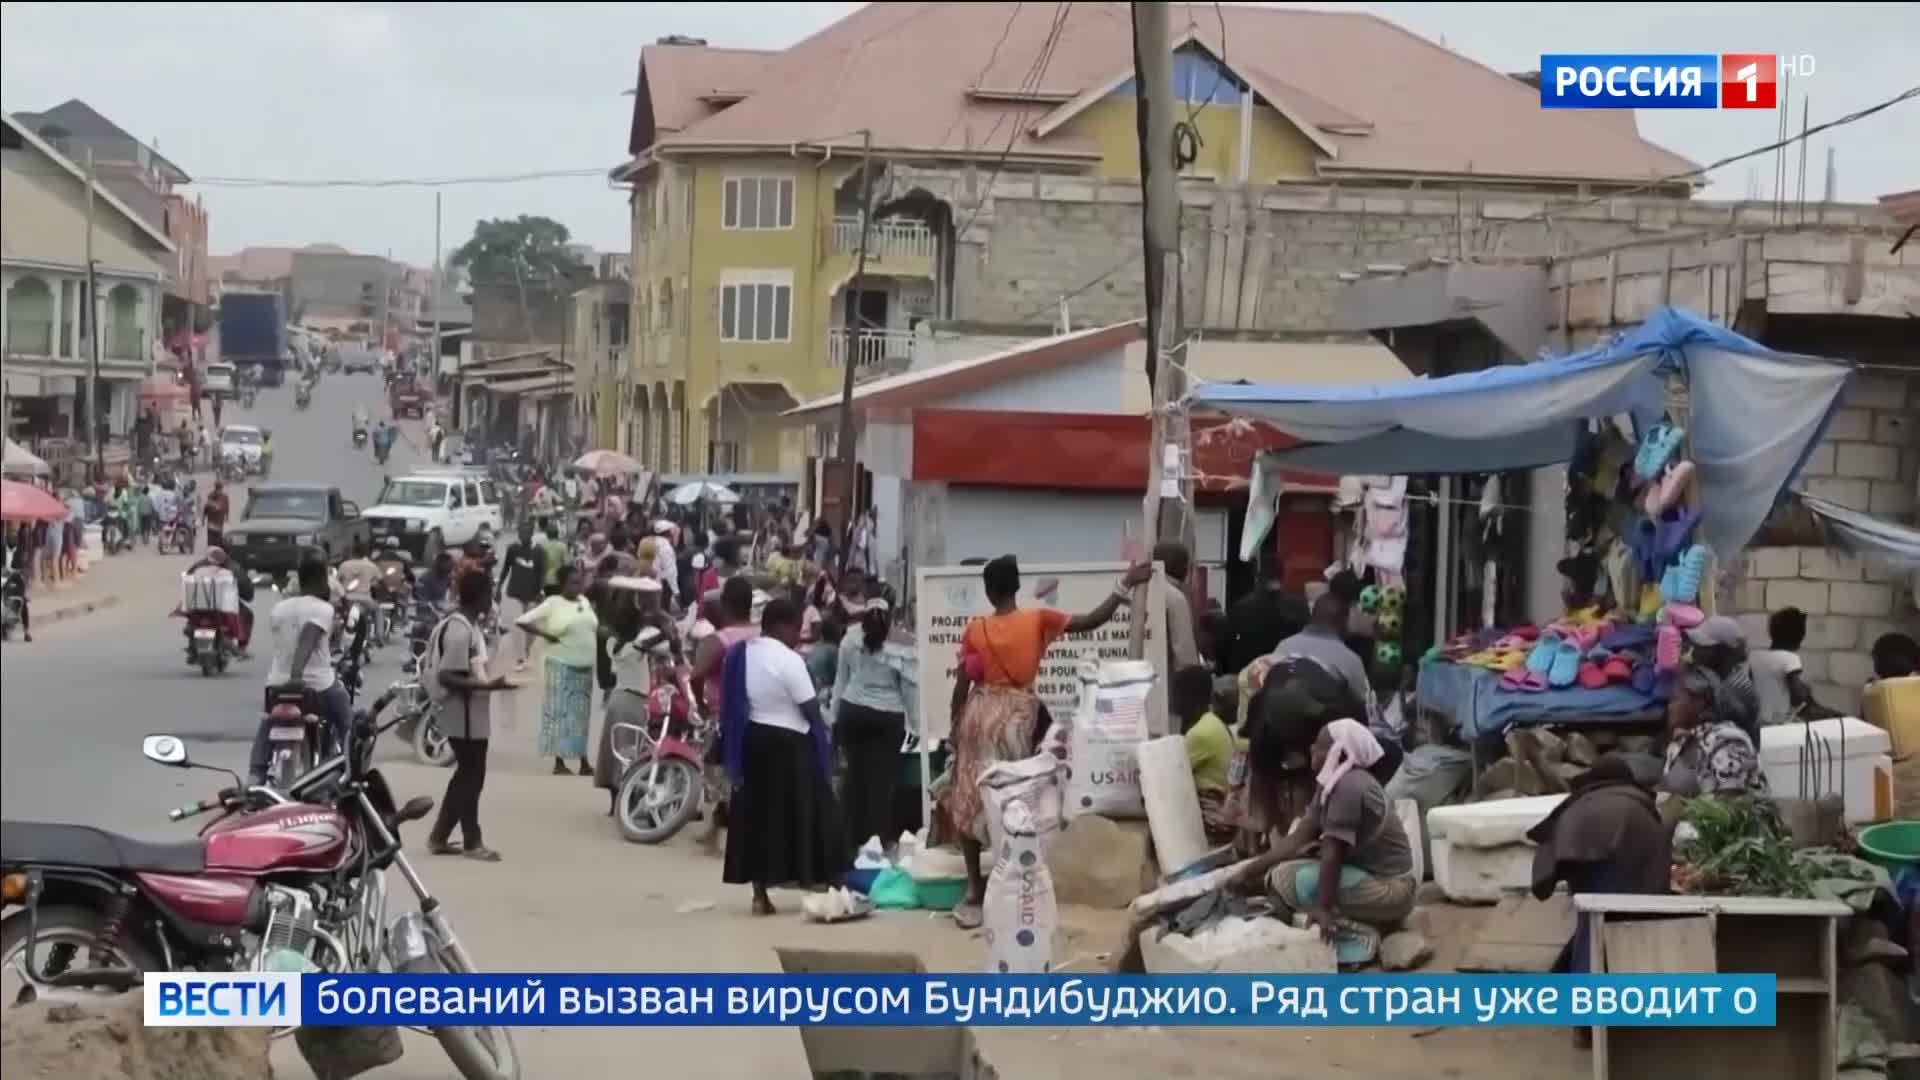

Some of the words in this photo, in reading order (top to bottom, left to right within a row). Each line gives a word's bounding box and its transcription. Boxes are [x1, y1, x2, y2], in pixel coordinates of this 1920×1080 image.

[931, 616, 969, 626] PROJET
[928, 634, 963, 644] INSTAL
[1096, 630, 1108, 641] LE
[1043, 648, 1079, 659] NTRAL
[1098, 647, 1129, 658] BUNIA
[1050, 666, 1078, 677] POUR
[1038, 683, 1057, 694] DES
[1059, 683, 1076, 694] POI
